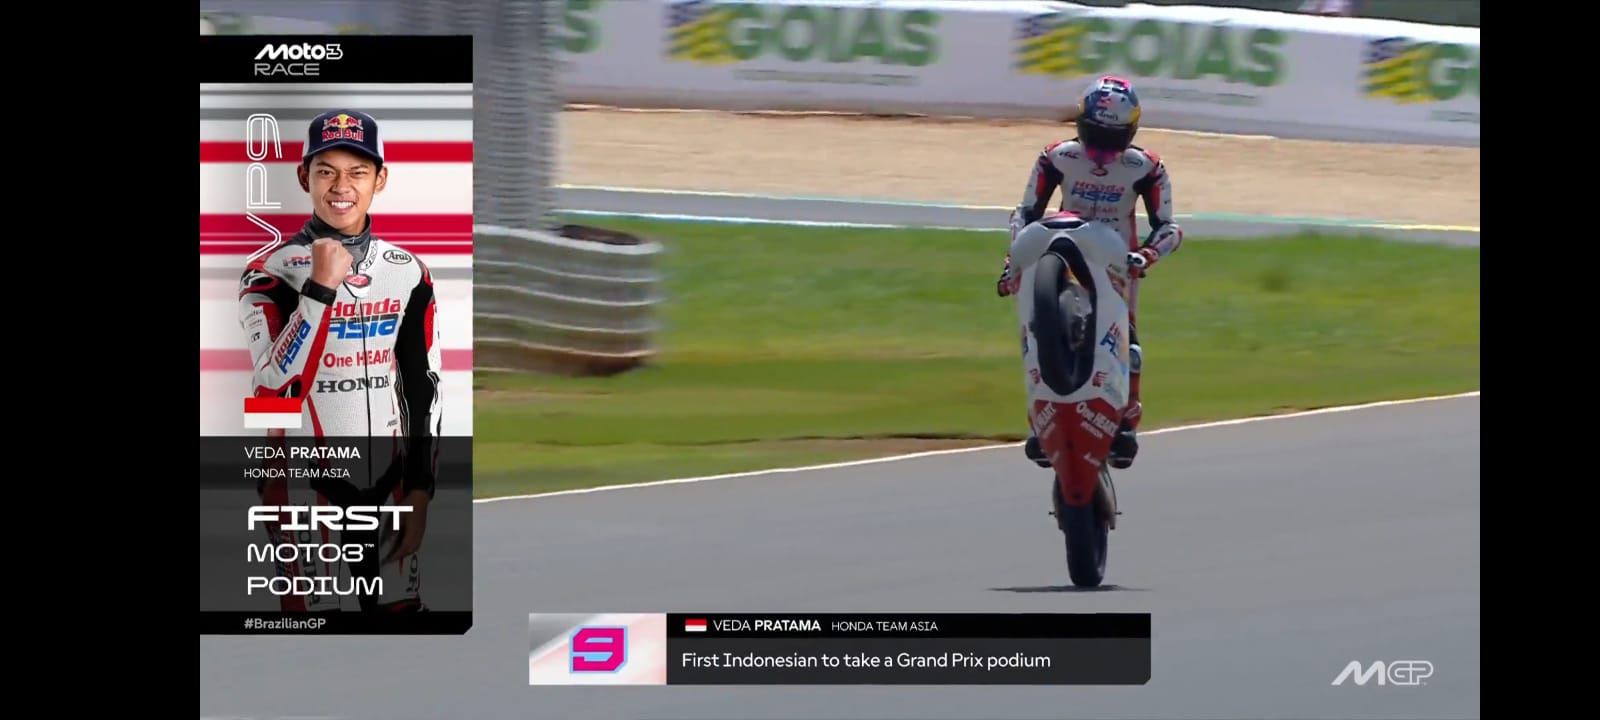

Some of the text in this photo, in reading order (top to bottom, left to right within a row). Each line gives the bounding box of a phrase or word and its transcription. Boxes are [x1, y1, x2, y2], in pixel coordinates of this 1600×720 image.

[344, 128, 363, 142] Bull
[323, 352, 353, 368] One
[316, 375, 390, 393] HONDA
